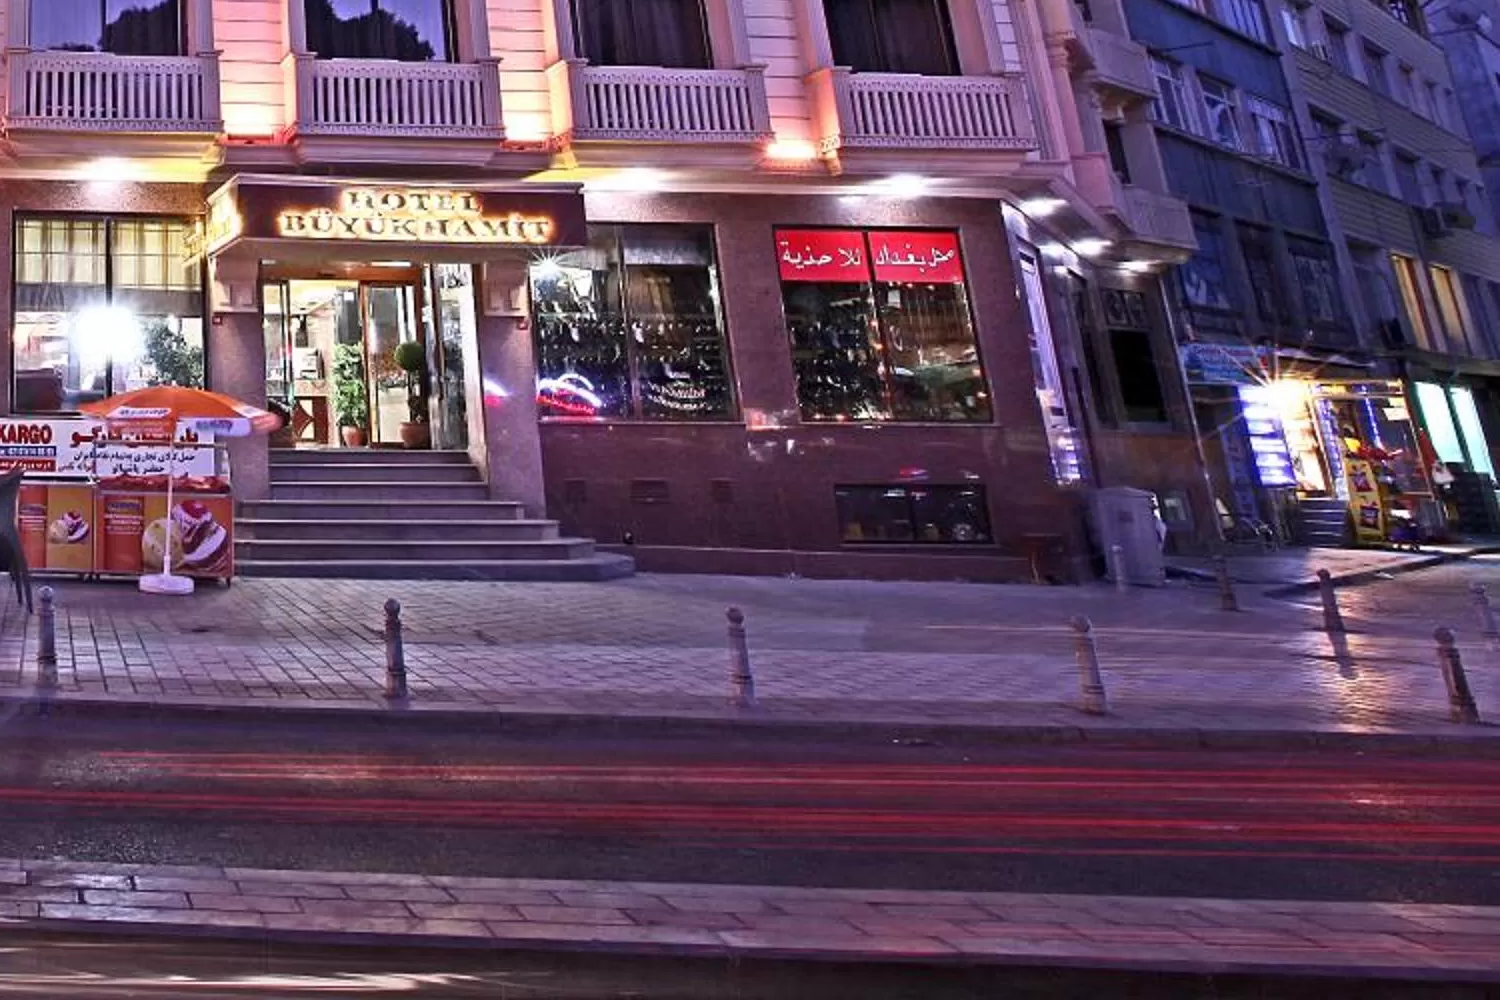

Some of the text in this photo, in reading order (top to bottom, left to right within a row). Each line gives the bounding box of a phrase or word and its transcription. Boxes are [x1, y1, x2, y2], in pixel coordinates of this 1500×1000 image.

[347, 191, 481, 212] HOTEL
[875, 243, 927, 273] بغداد
[929, 247, 955, 268] محل
